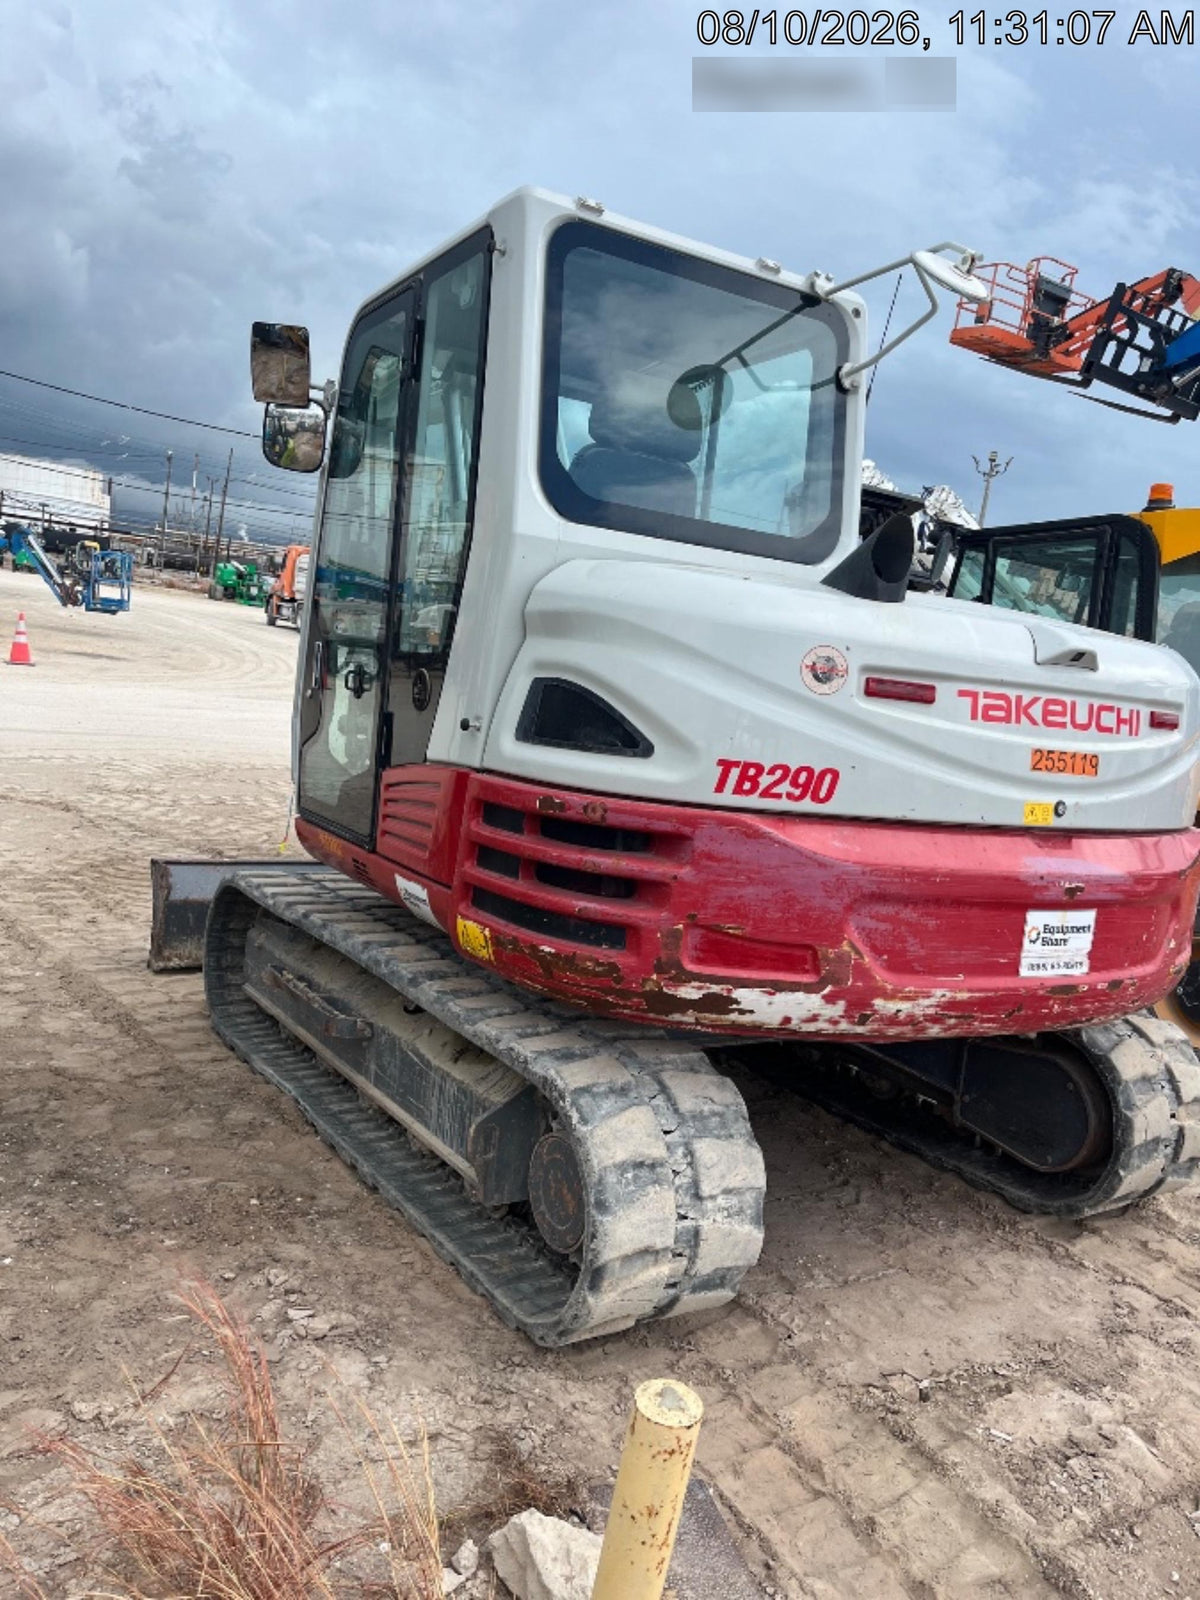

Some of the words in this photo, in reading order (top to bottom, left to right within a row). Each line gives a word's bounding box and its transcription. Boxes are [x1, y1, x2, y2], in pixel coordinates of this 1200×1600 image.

[957, 689, 1141, 736] TAKEUCHI
[713, 758, 840, 804] TB290
[1031, 748, 1099, 776] 255119
